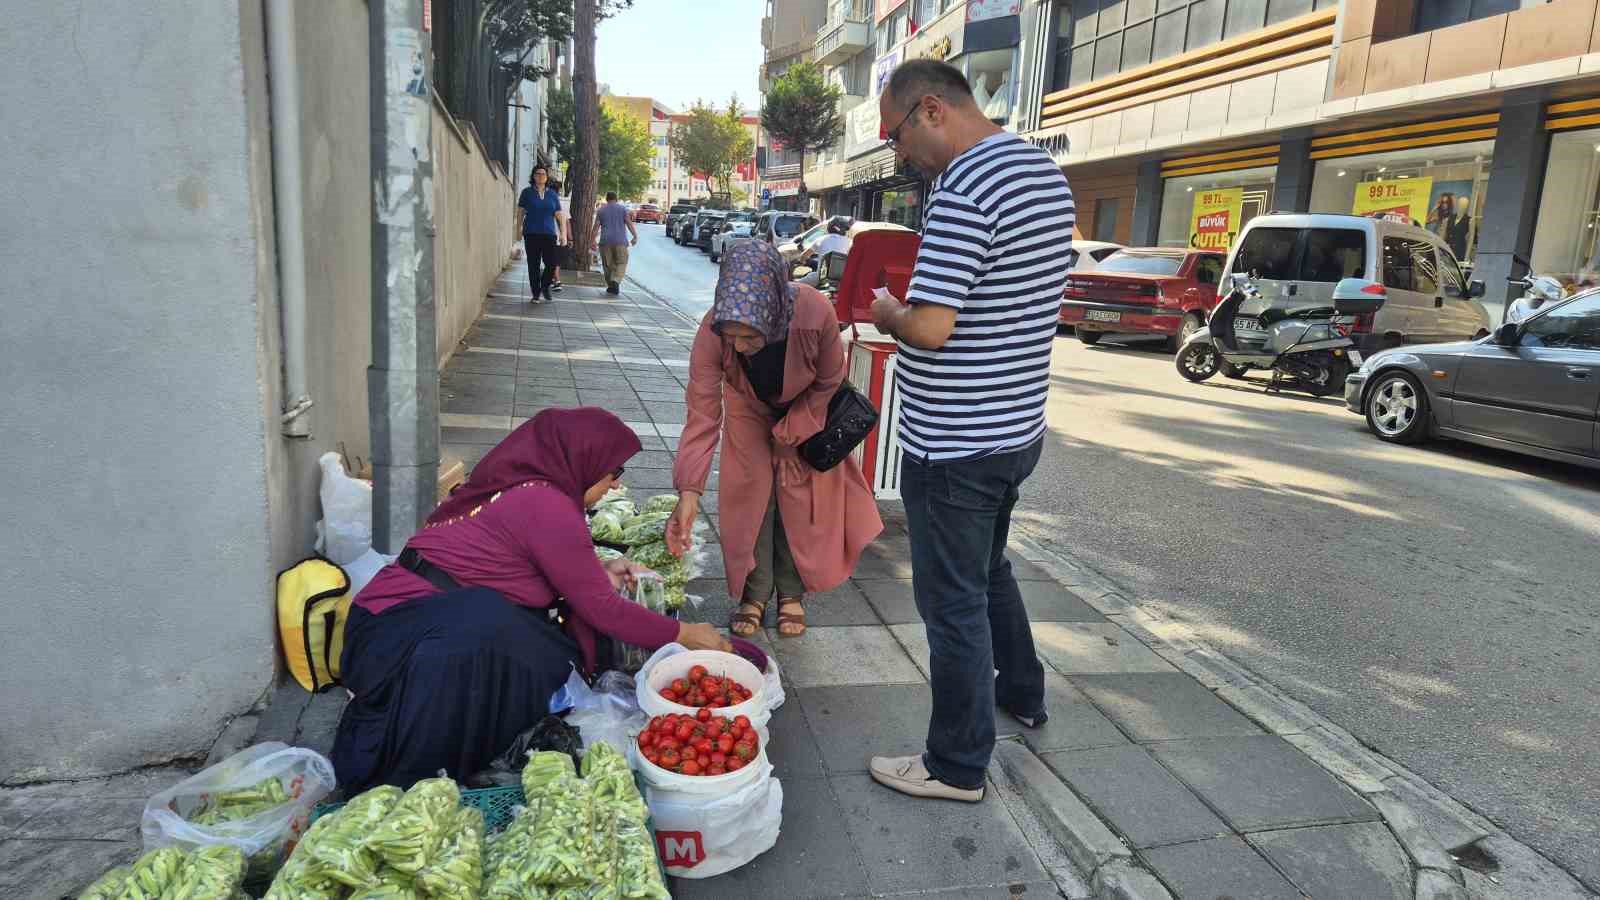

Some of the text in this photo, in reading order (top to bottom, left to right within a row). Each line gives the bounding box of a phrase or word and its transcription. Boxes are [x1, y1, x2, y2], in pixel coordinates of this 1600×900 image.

[1369, 185, 1384, 198] 99
[1386, 184, 1398, 197] TL
[1200, 215, 1226, 228] BÜYÜK
[1191, 232, 1236, 247] OUTLET
[664, 837, 697, 862] M
